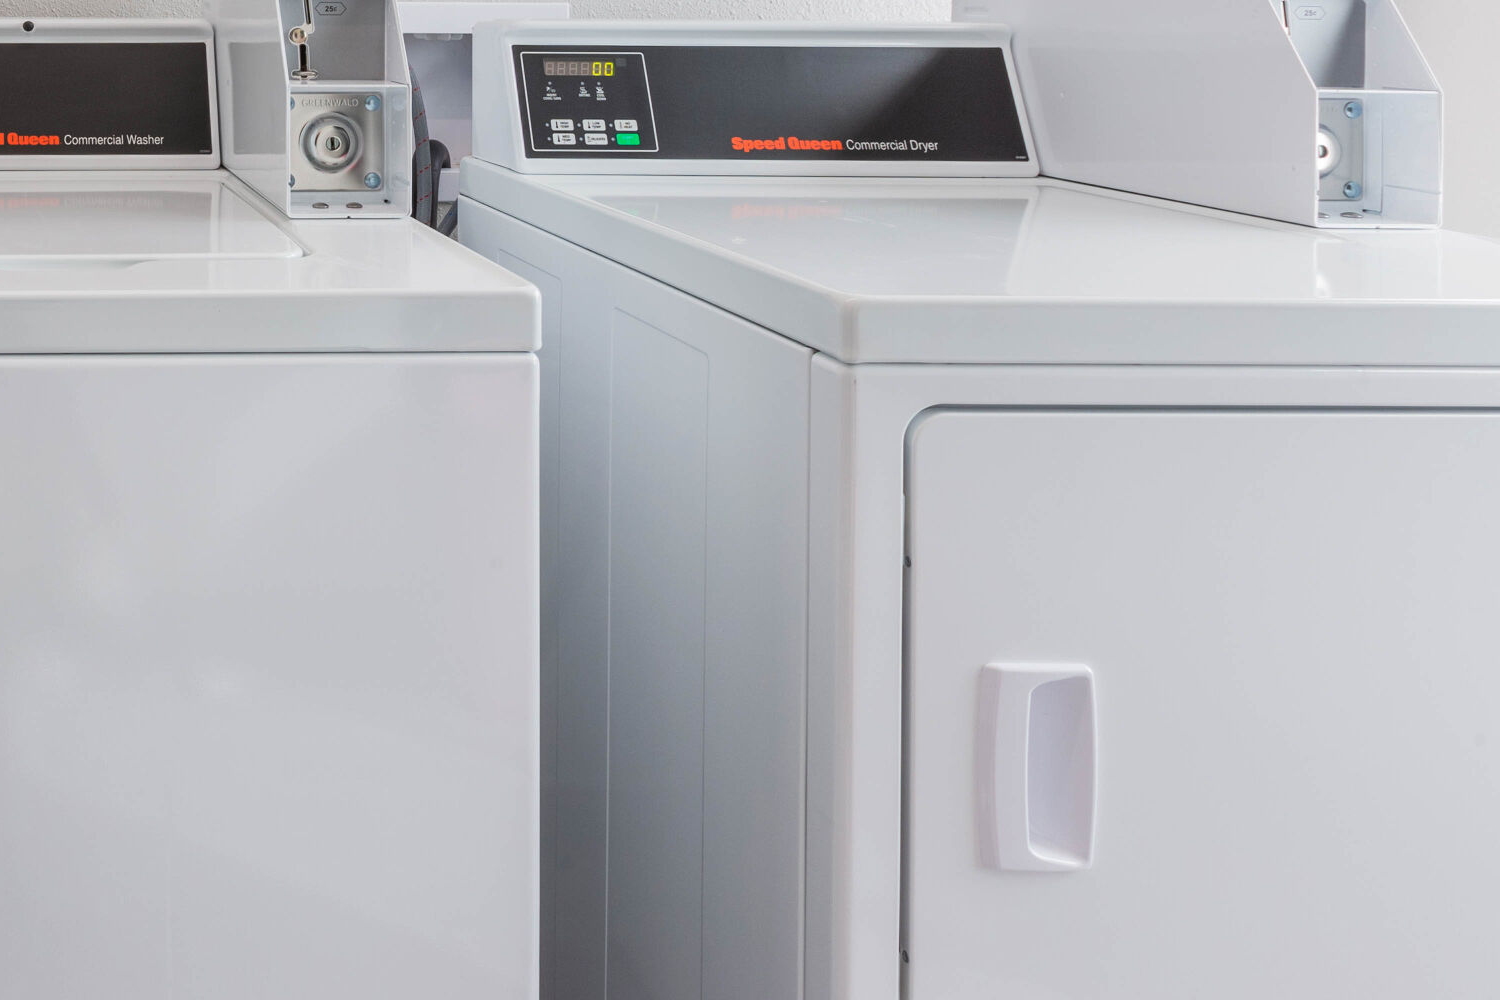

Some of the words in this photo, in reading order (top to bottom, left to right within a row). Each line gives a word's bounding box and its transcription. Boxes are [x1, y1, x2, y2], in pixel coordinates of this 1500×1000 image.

[7, 132, 59, 146] Queen
[63, 133, 124, 146] Commercial
[126, 133, 165, 146] Washer
[732, 136, 786, 152] Speed
[788, 136, 843, 150] Queen
[846, 138, 908, 151] Commercial
[910, 140, 939, 153] Dryer
